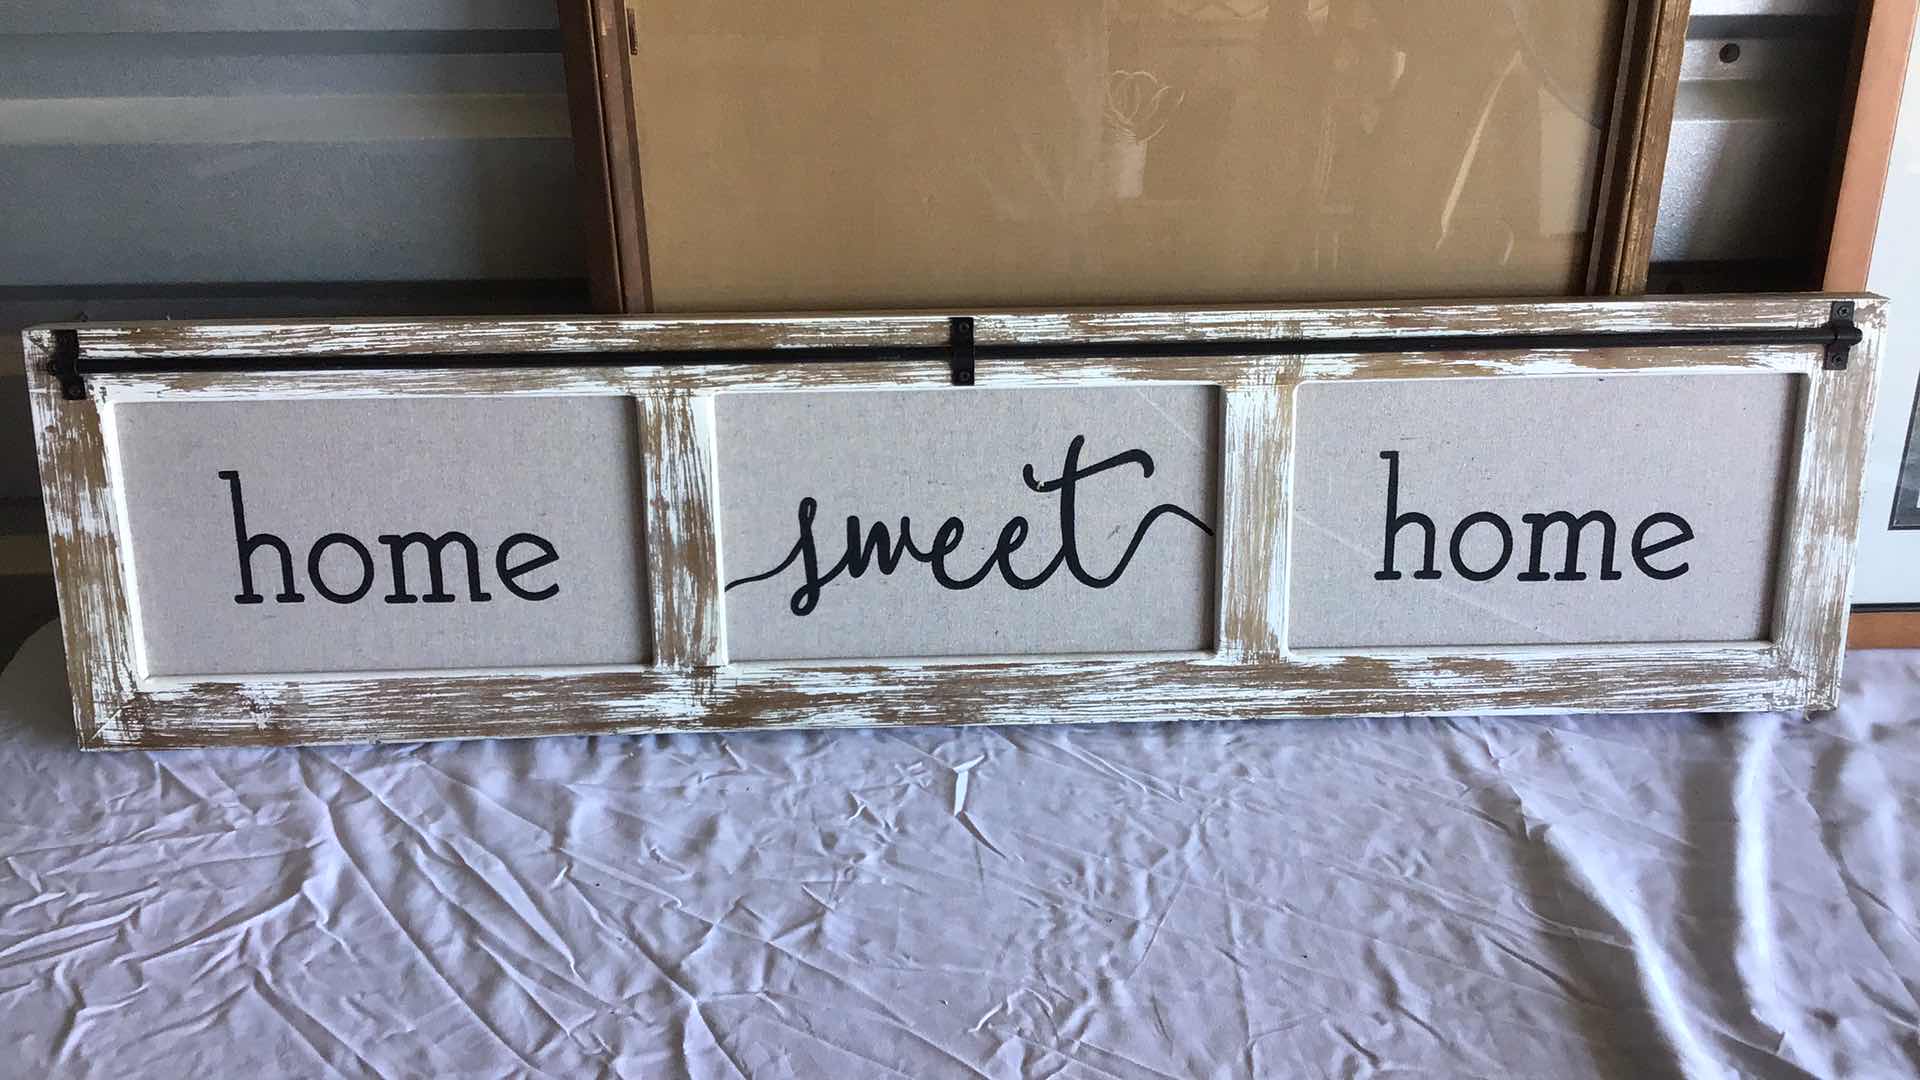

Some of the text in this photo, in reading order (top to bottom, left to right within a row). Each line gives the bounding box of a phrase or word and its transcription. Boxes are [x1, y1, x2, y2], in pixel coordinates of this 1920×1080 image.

[218, 434, 1695, 616] home sweet home
